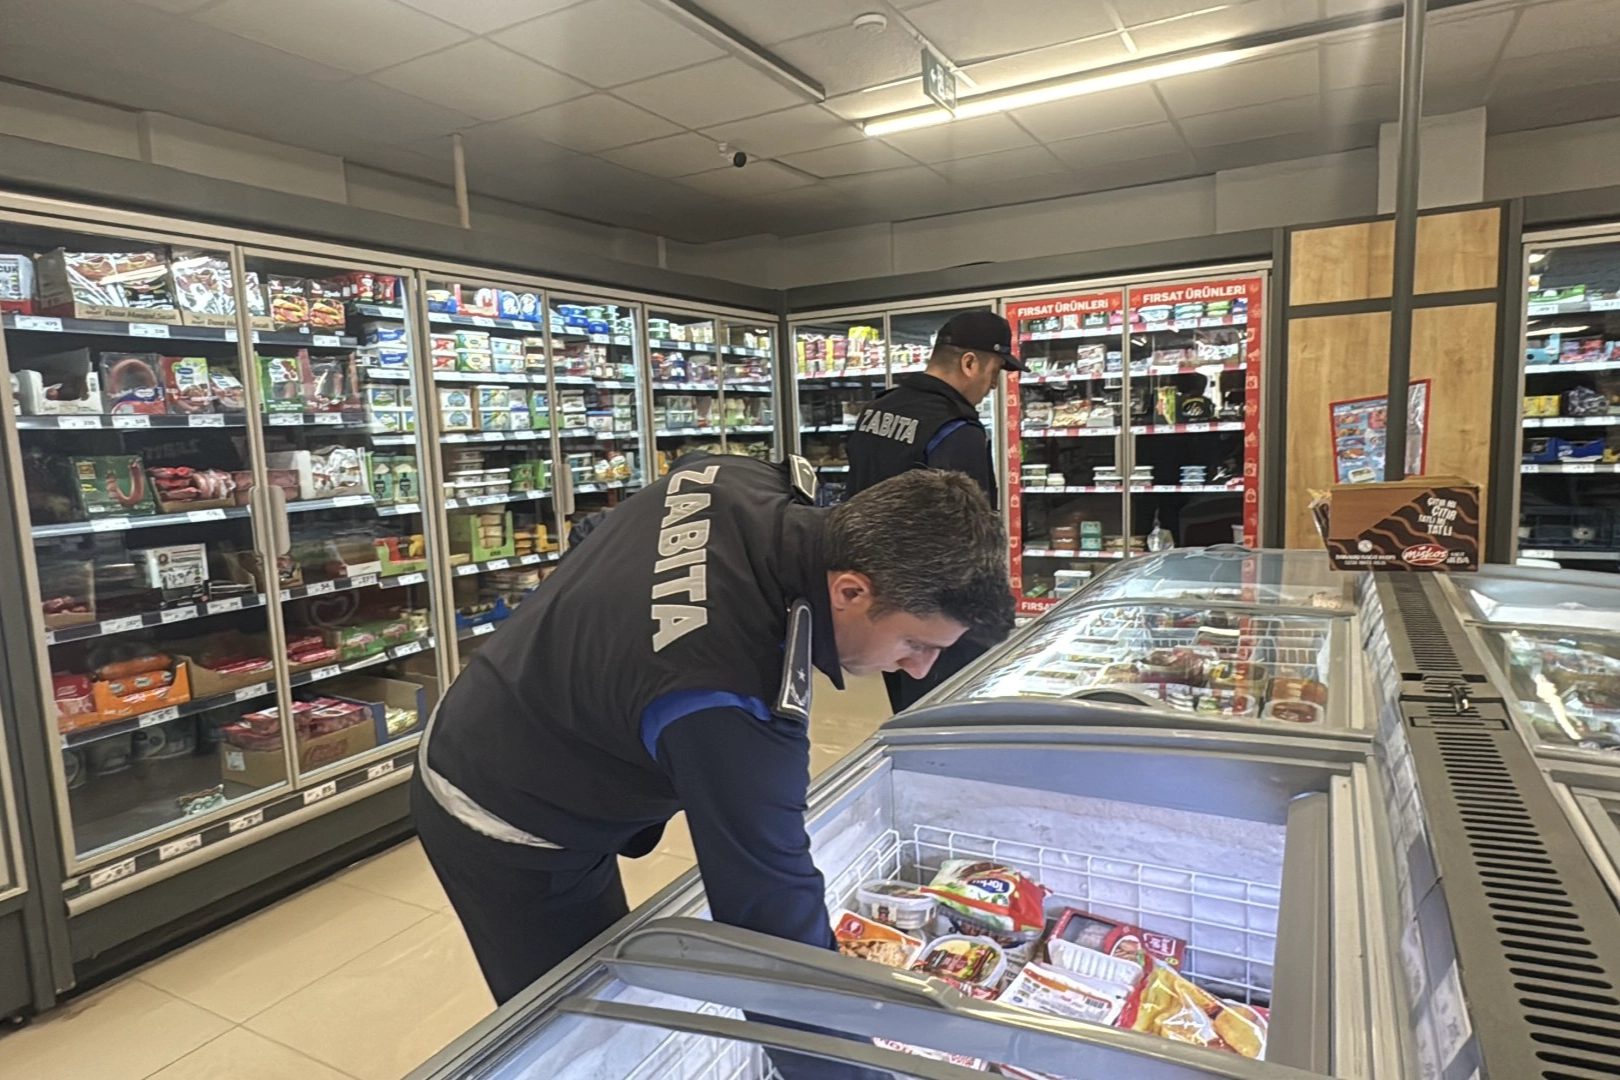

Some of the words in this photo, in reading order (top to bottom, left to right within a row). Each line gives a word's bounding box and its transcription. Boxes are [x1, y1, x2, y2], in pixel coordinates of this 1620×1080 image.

[1017, 304, 1054, 317] FIRSAT
[1055, 299, 1109, 313] ÜRÜNLERİ
[1143, 290, 1184, 304] FIRSAT
[1185, 284, 1246, 300] ÜRÜNLERİ
[858, 408, 919, 445] ZABITA
[651, 465, 721, 653] ZABITA
